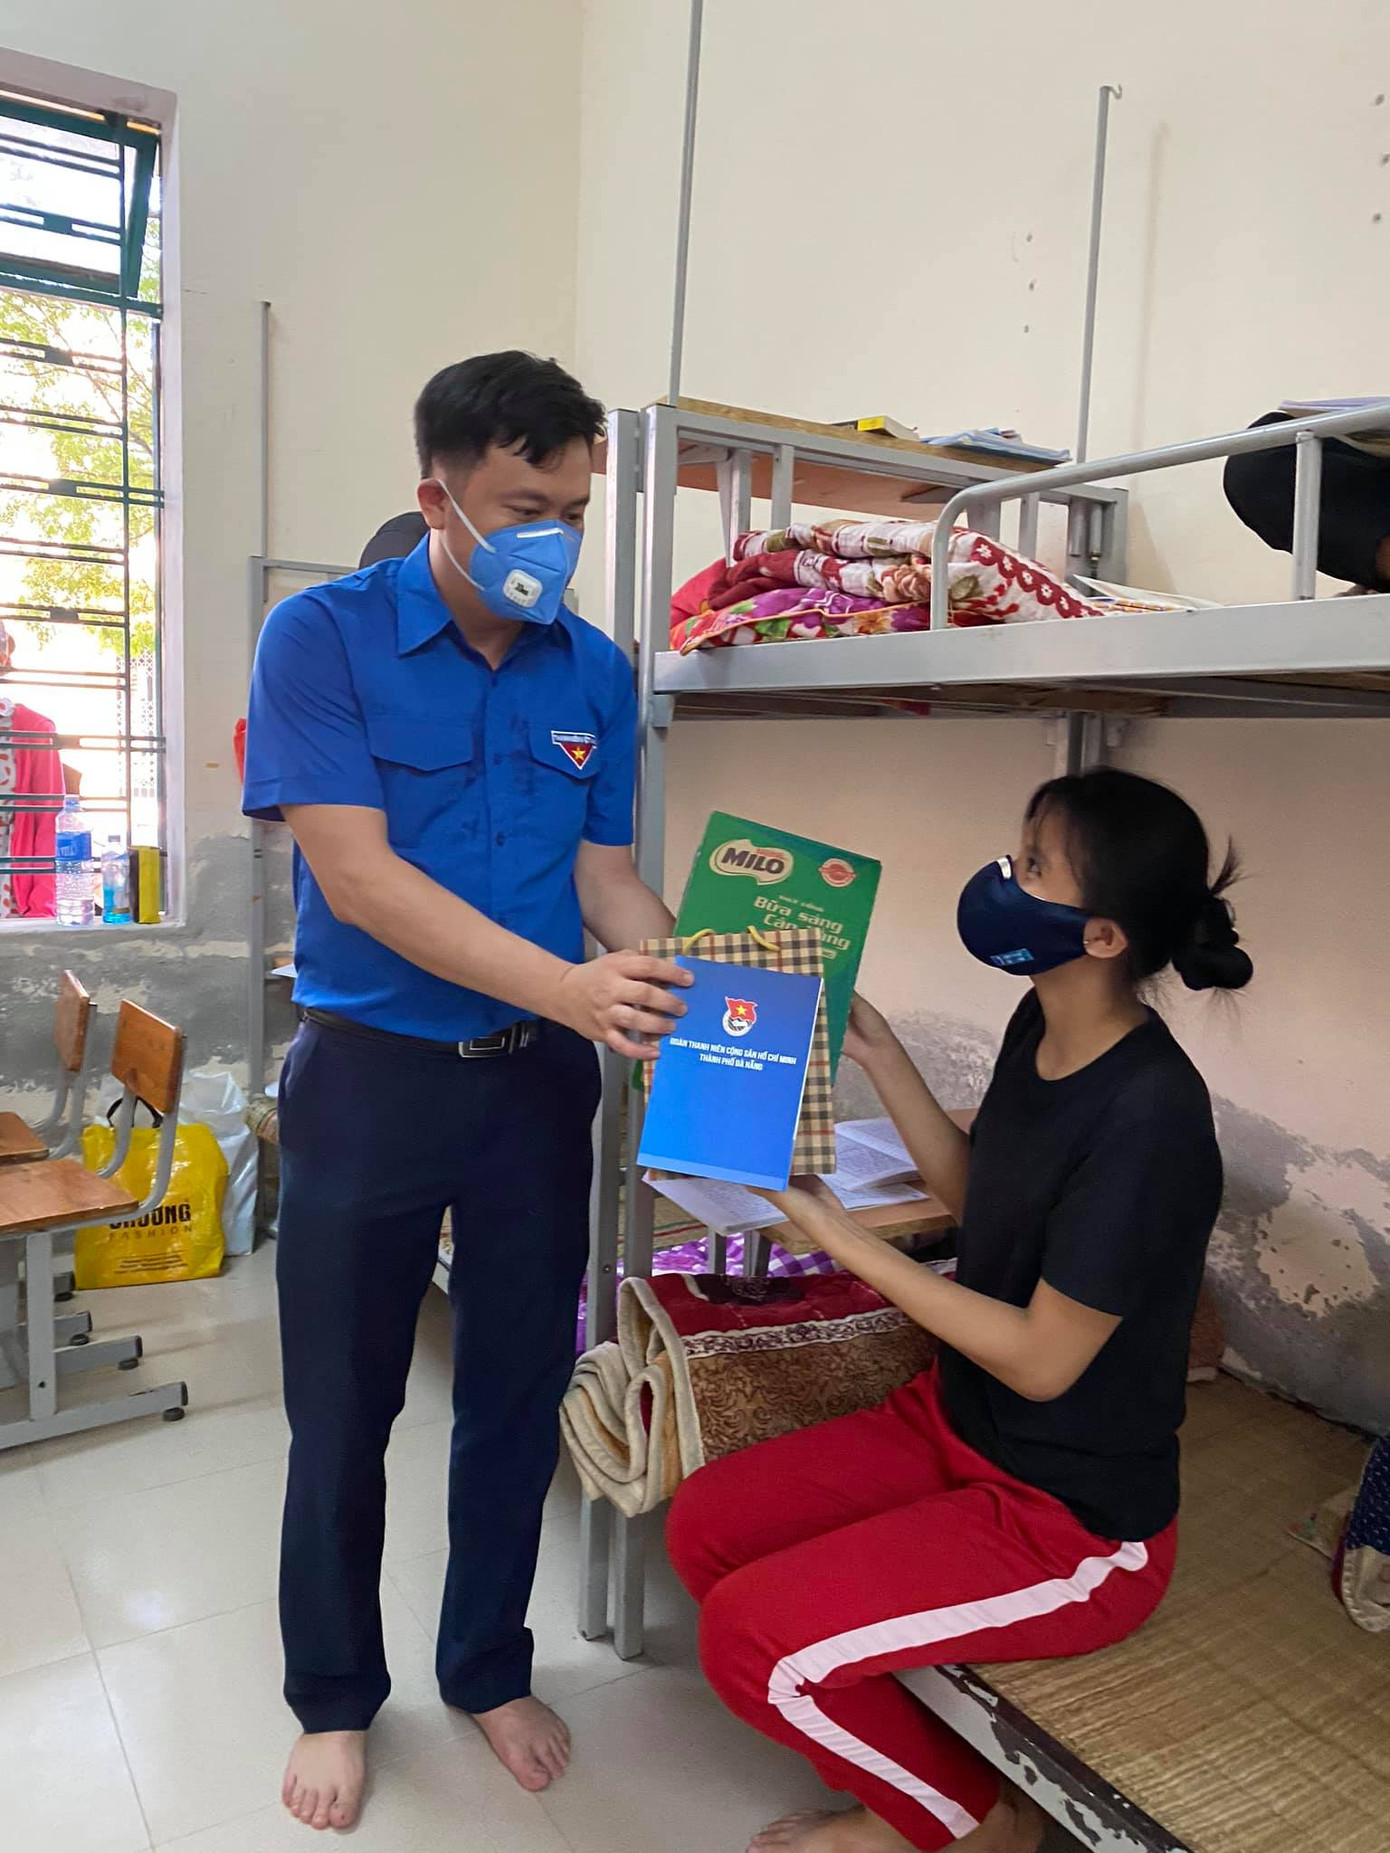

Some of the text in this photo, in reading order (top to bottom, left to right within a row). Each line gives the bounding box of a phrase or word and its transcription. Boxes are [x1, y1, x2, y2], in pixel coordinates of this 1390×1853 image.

[721, 847, 785, 875] MILO
[754, 896, 792, 916] Bữa
[797, 912, 844, 934] sáng
[688, 1040, 710, 1051] THANH
[710, 1043, 726, 1054] NIÊN
[726, 1046, 743, 1057] CỘNG
[768, 1053, 780, 1062] CHÍ
[779, 1055, 797, 1065] MINH
[700, 1053, 721, 1064] THÀNH
[721, 1056, 736, 1066] PHỐ
